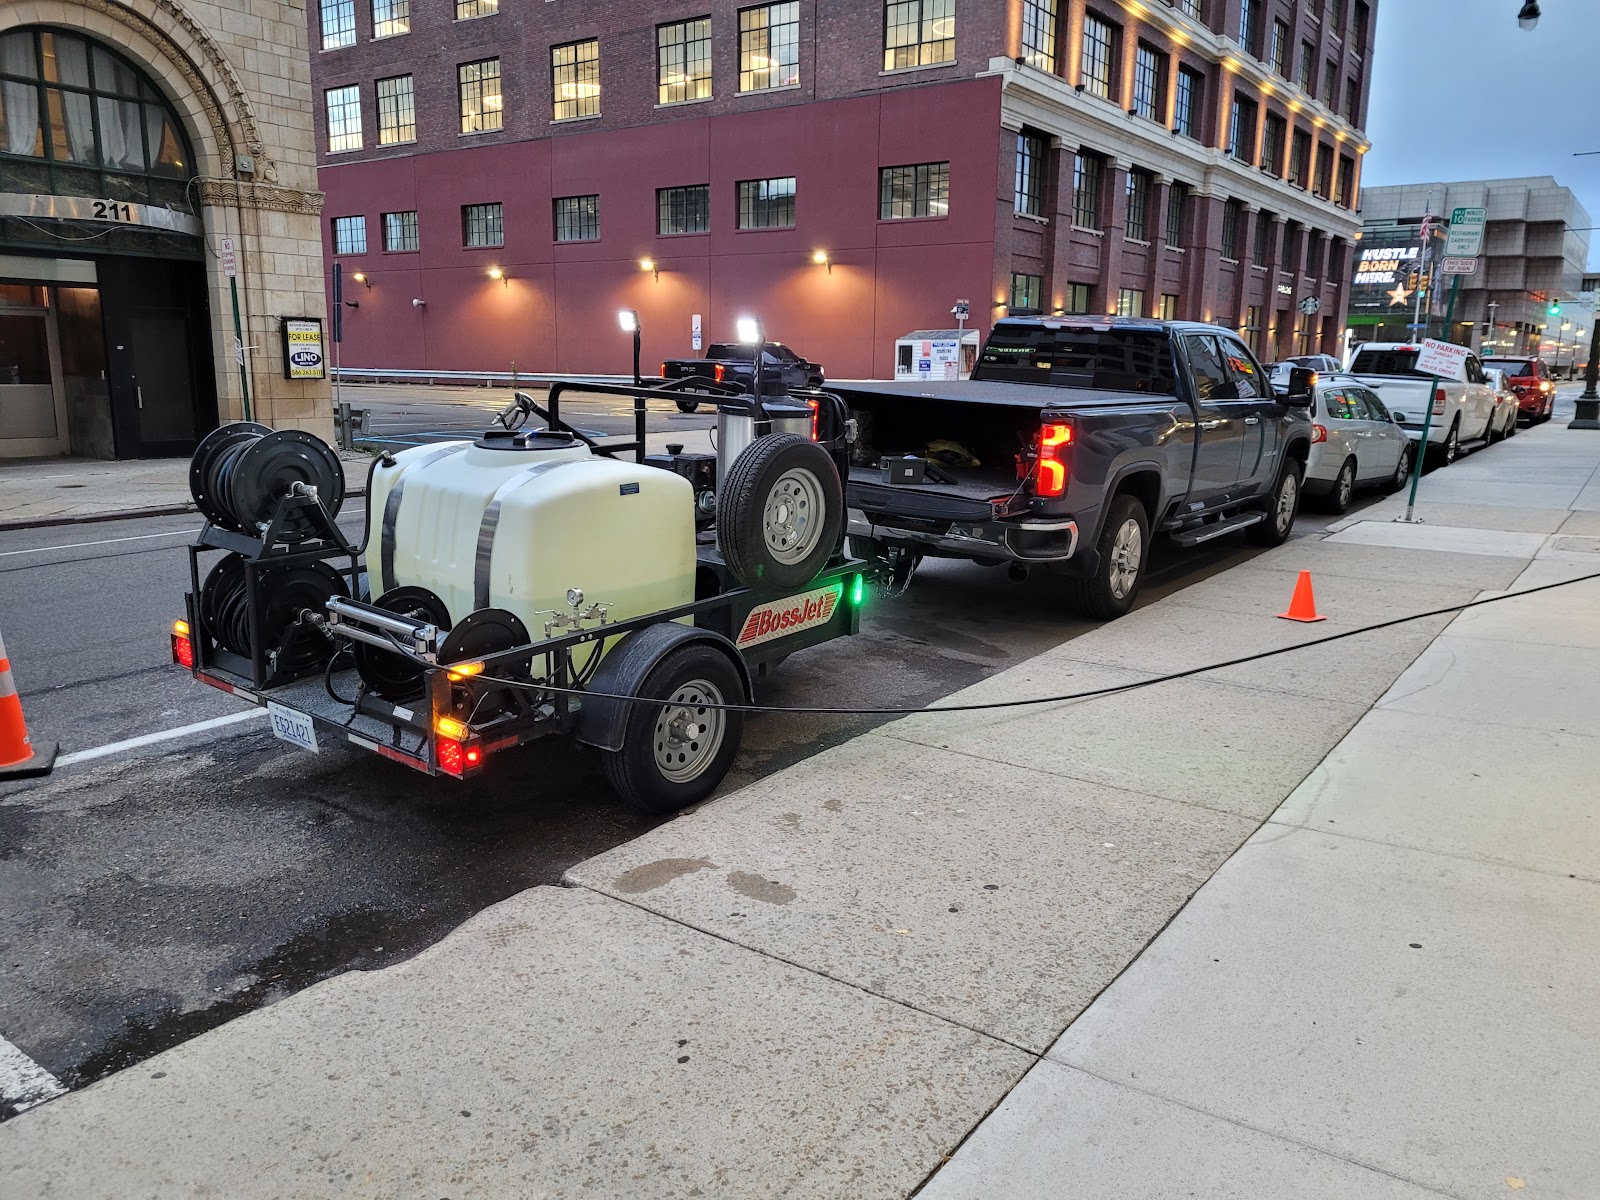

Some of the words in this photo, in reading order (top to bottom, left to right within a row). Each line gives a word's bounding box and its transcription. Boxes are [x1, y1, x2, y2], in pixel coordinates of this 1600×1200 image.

[93, 201, 131, 221] 211
[1453, 215, 1464, 223] 10
[1361, 247, 1419, 260] HUSTLE
[1358, 260, 1399, 272] BORN
[288, 333, 301, 341] FOR
[303, 333, 321, 342] LEASE
[1426, 341, 1436, 349] NO
[1437, 344, 1466, 357] PARKING
[1434, 350, 1454, 358] SUNDAY
[294, 352, 318, 362] LINO
[1421, 363, 1438, 371] POLICE
[1439, 367, 1456, 376] ORDER
[758, 596, 823, 636] BossJet
[274, 714, 312, 744] E621421
